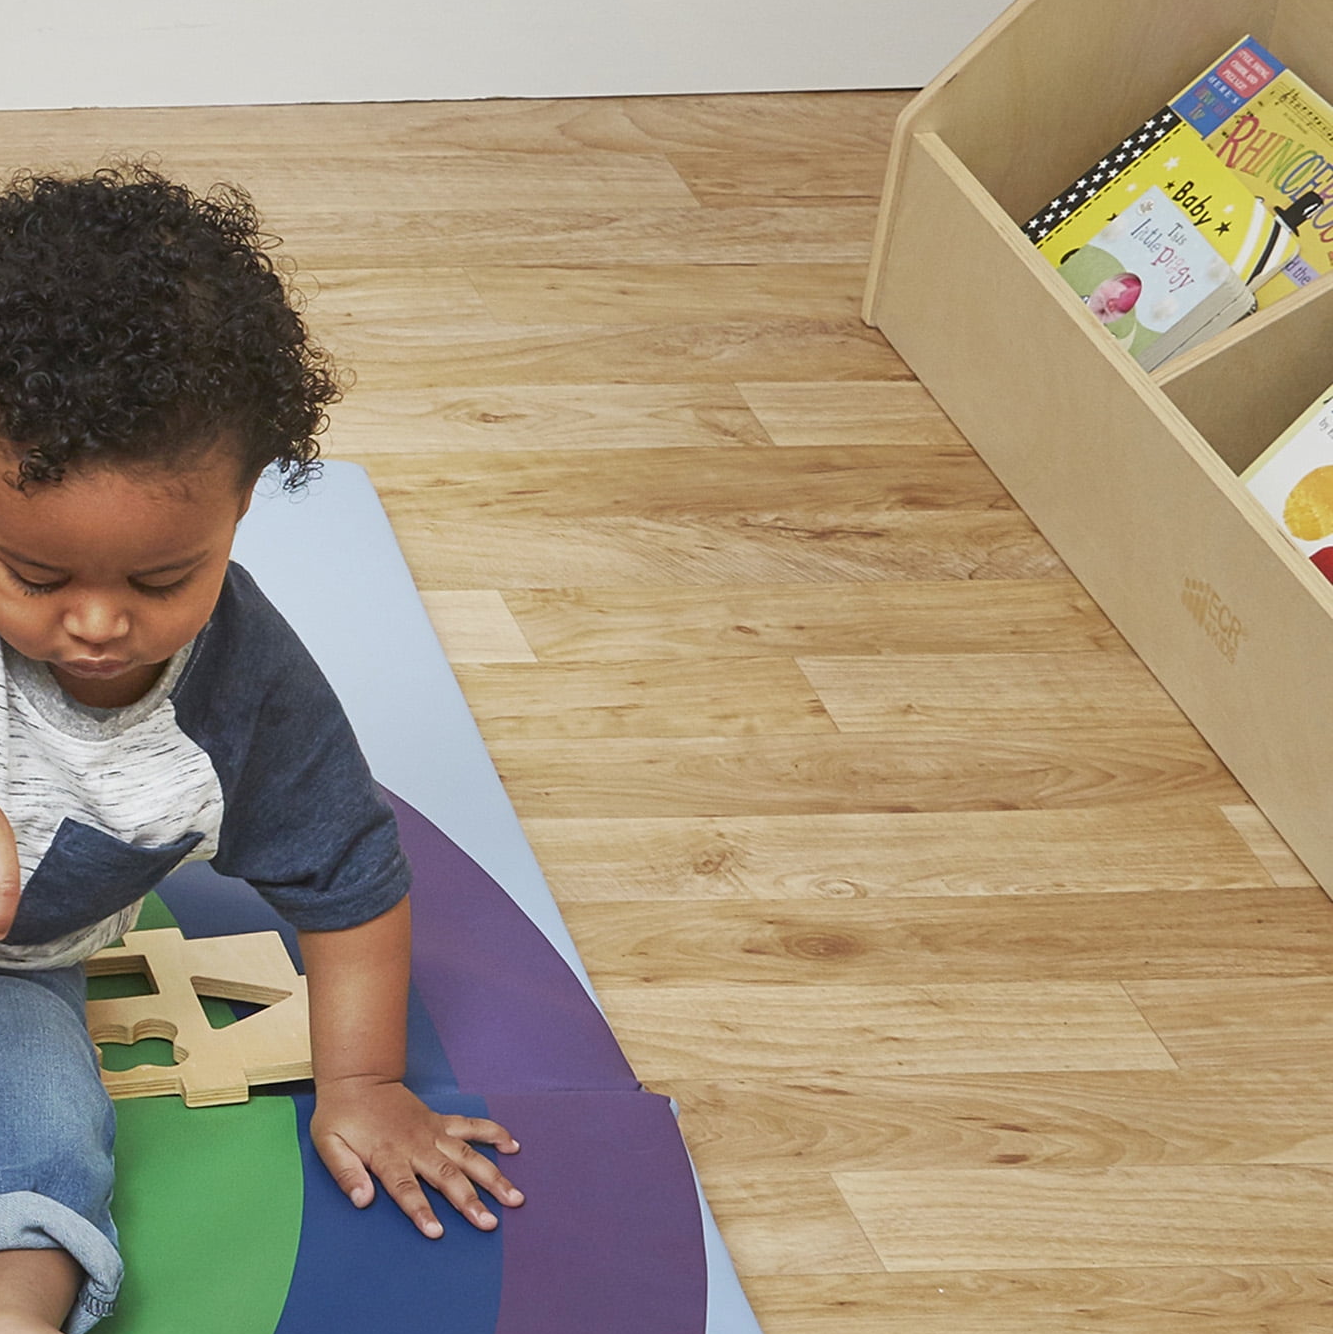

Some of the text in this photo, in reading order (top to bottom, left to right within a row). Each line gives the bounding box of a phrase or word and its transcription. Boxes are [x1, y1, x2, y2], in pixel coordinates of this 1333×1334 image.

[1172, 180, 1212, 226] Baby
[1167, 222, 1188, 246] This
[1130, 218, 1195, 293] little piggy
[1292, 266, 1312, 286] the
